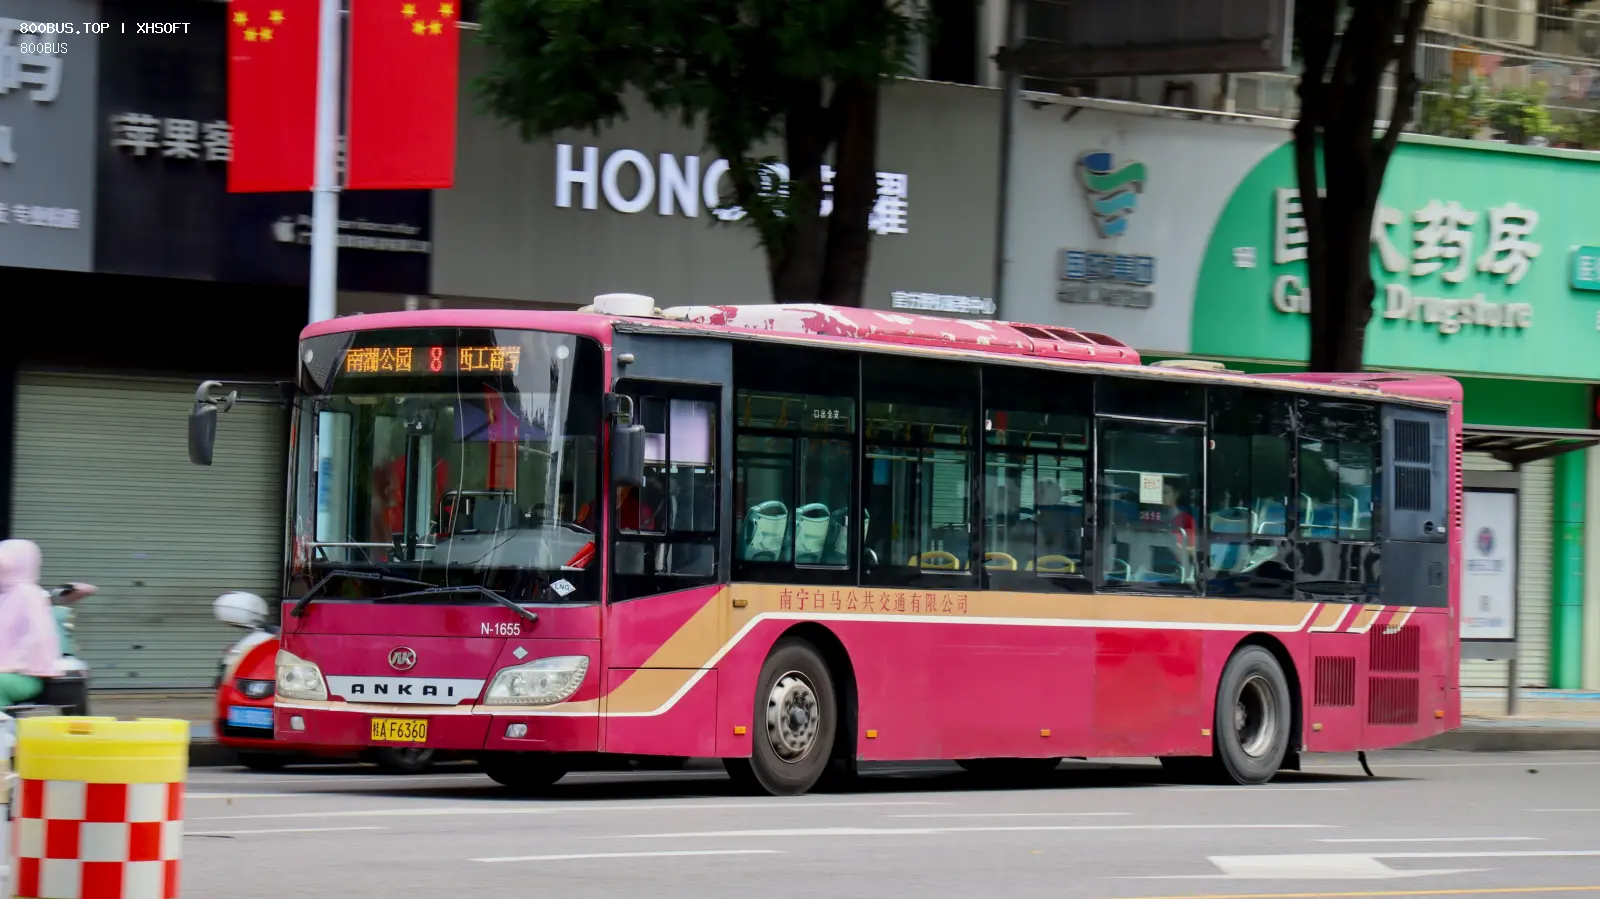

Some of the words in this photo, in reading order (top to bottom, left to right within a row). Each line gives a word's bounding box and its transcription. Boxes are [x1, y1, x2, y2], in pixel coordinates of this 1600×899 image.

[1383, 283, 1532, 334] Drugstore
[347, 347, 413, 373] 南湖公园
[430, 347, 443, 372] 8
[554, 582, 571, 592] LNG
[779, 588, 969, 614] 南宁白马公共交通有限公司
[480, 622, 521, 636] N-1655
[351, 683, 454, 698] ANKAI
